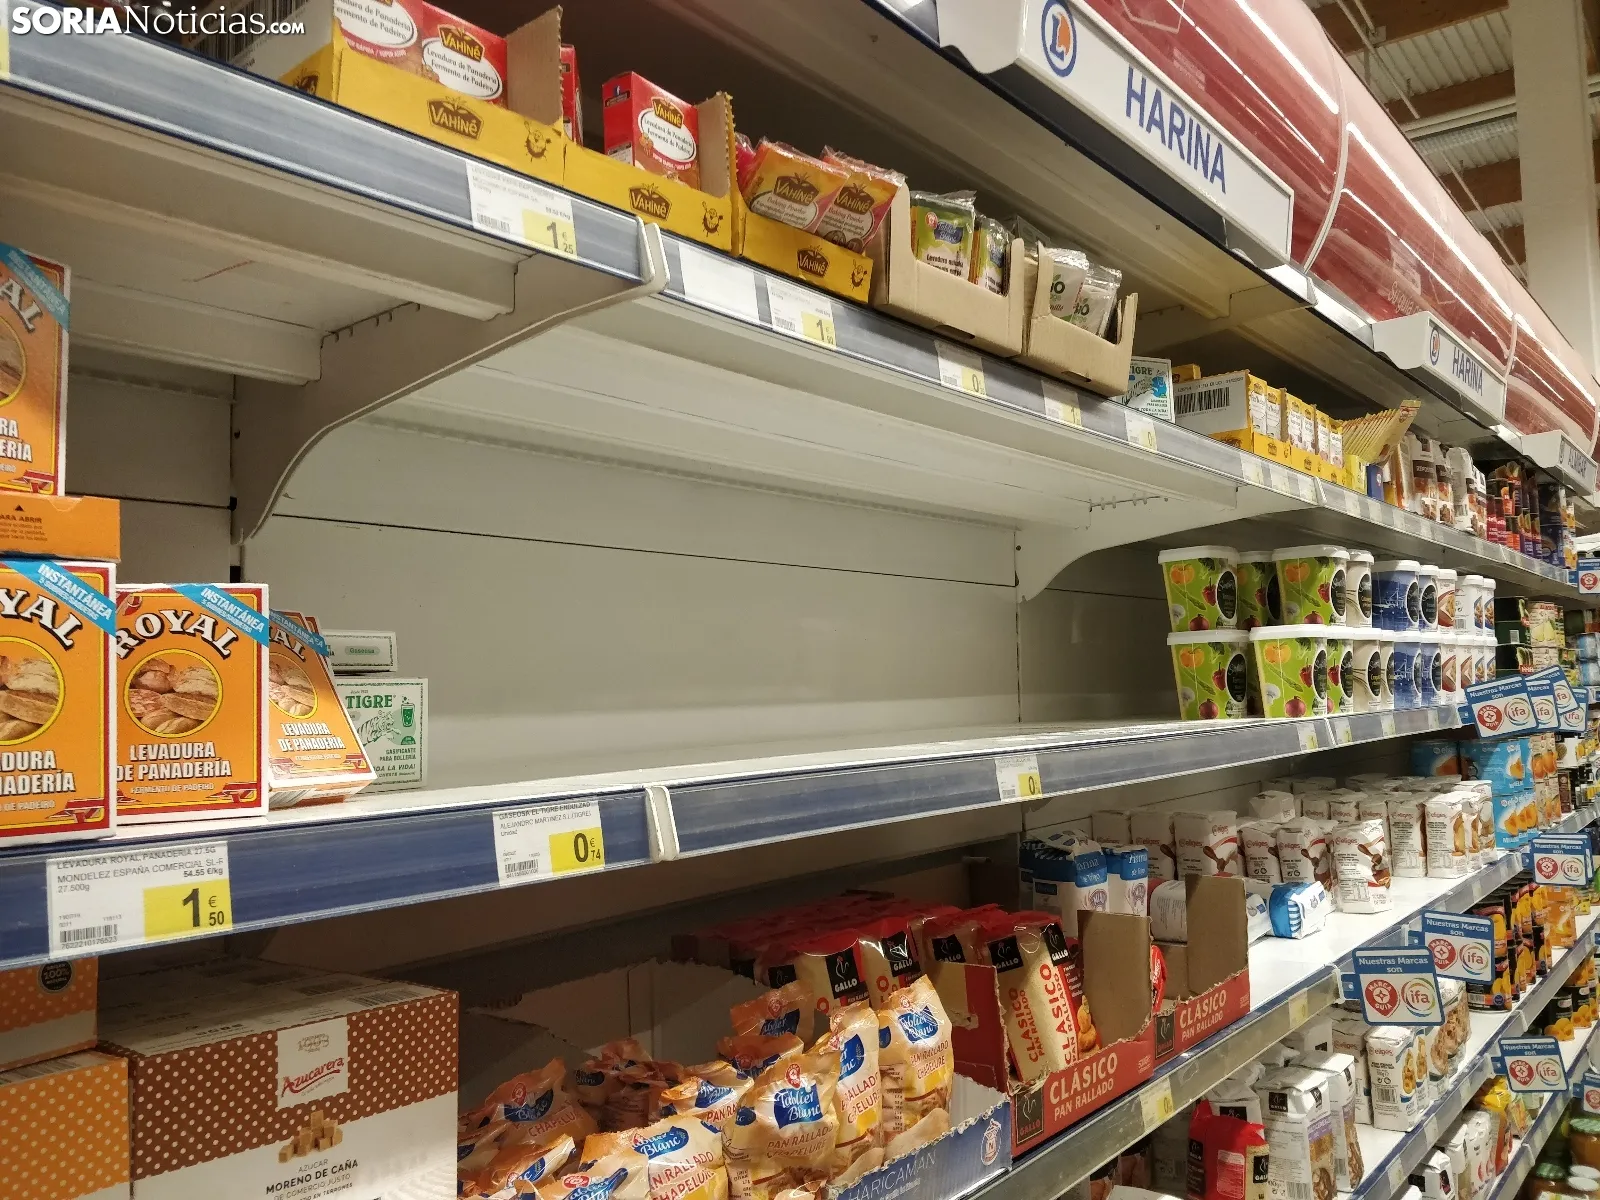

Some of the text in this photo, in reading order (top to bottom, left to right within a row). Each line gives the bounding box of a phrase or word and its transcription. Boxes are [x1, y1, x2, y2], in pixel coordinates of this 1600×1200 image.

[427, 47, 457, 67] Levadura
[458, 60, 467, 70] de
[431, 59, 494, 93] Fermento de Padeiro
[1125, 64, 1227, 194] HARINA
[1452, 346, 1484, 397] HARINA
[37, 563, 113, 621] INSTANTÁNEA
[201, 587, 265, 633] INSTANTÁNEA
[116, 609, 239, 660] ROYAL
[1469, 683, 1523, 698] Nuestras Marcas
[345, 694, 392, 710] TIGRE
[1511, 707, 1527, 717] ifa
[1536, 707, 1551, 716] ifa
[281, 722, 332, 737] LEVADURA
[129, 741, 216, 763] LEVADURA
[277, 739, 293, 751] DE
[138, 757, 232, 781] PANADERÍA
[1029, 775, 1036, 796] 0
[499, 809, 531, 820] GASEOSA
[531, 808, 540, 816] EL
[541, 804, 559, 814] TIGRE
[500, 819, 534, 830] ALEJANDRO
[573, 832, 589, 863] 0
[591, 849, 601, 861] 74
[57, 858, 108, 870] LEVADURA
[57, 870, 111, 883] MONDELEZ
[113, 865, 150, 878] ESPAÑA
[152, 860, 203, 874] COMERCIAL
[1566, 864, 1579, 874] ifa
[183, 867, 224, 878] 54.55 €/kg
[182, 888, 201, 928] 1
[208, 896, 218, 908] €
[208, 911, 225, 927] 50
[1426, 919, 1489, 933] Nuestras Marcas
[1450, 929, 1465, 937] son
[1431, 940, 1452, 951] MARCA
[996, 958, 1019, 969] GALLO
[1052, 950, 1069, 961] GALLO
[1359, 957, 1429, 965] Nuestras Marcas
[1467, 951, 1484, 964] ifa
[893, 958, 914, 971] GALLO
[834, 977, 858, 993] GALLO
[1368, 981, 1393, 992] MARCA
[1054, 973, 1073, 1032] RALLADO
[1410, 989, 1430, 1004] ifa
[1020, 989, 1038, 1034] RALLADO
[1179, 990, 1227, 1029] CLÁSICO
[1375, 1003, 1393, 1011] GUIA
[1182, 1011, 1224, 1041] PAN RALLADO
[281, 1057, 345, 1098] Azucarera
[1049, 1052, 1118, 1105] CLÁSICO
[1542, 1067, 1557, 1077] ifa
[777, 1087, 814, 1107] Tablier
[1054, 1078, 1114, 1121] PAN RALLADO
[706, 1109, 726, 1123] PAN
[788, 1104, 821, 1121] Blanc
[767, 1121, 835, 1149] PAN RALLADO
[640, 1136, 681, 1157] Blanc
[665, 1151, 714, 1182] RALLADO
[265, 1159, 359, 1195] MORENO DE CAÑA
[286, 1181, 327, 1199] COMERCIO
[326, 1173, 351, 1187] JUSTO
[323, 1182, 353, 1196] TERRONES
